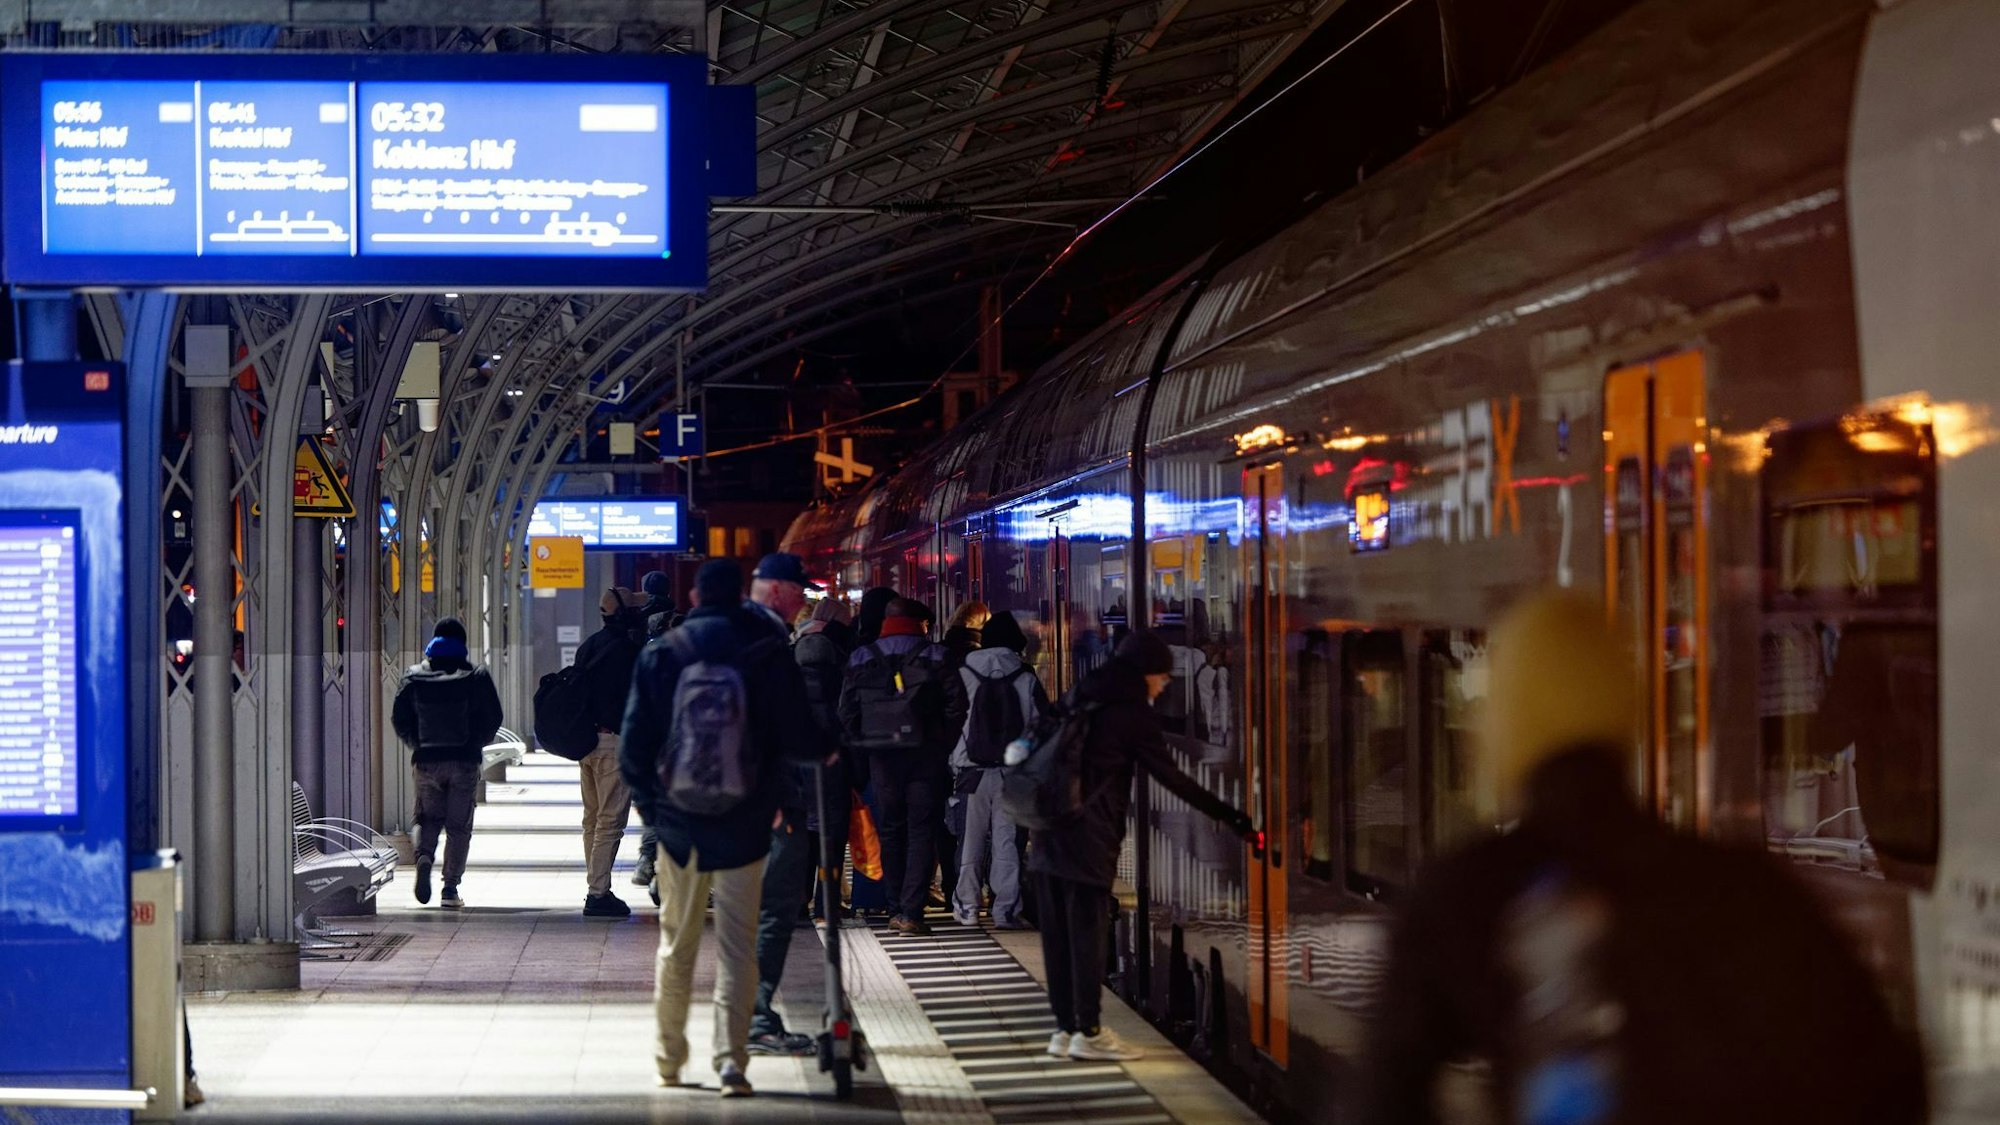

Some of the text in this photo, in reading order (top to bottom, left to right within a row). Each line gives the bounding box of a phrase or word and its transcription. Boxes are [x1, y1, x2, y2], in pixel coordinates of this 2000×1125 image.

[371, 102, 445, 132] 05:32
[372, 139, 516, 170] Koblenz Hbf
[677, 414, 697, 447] F
